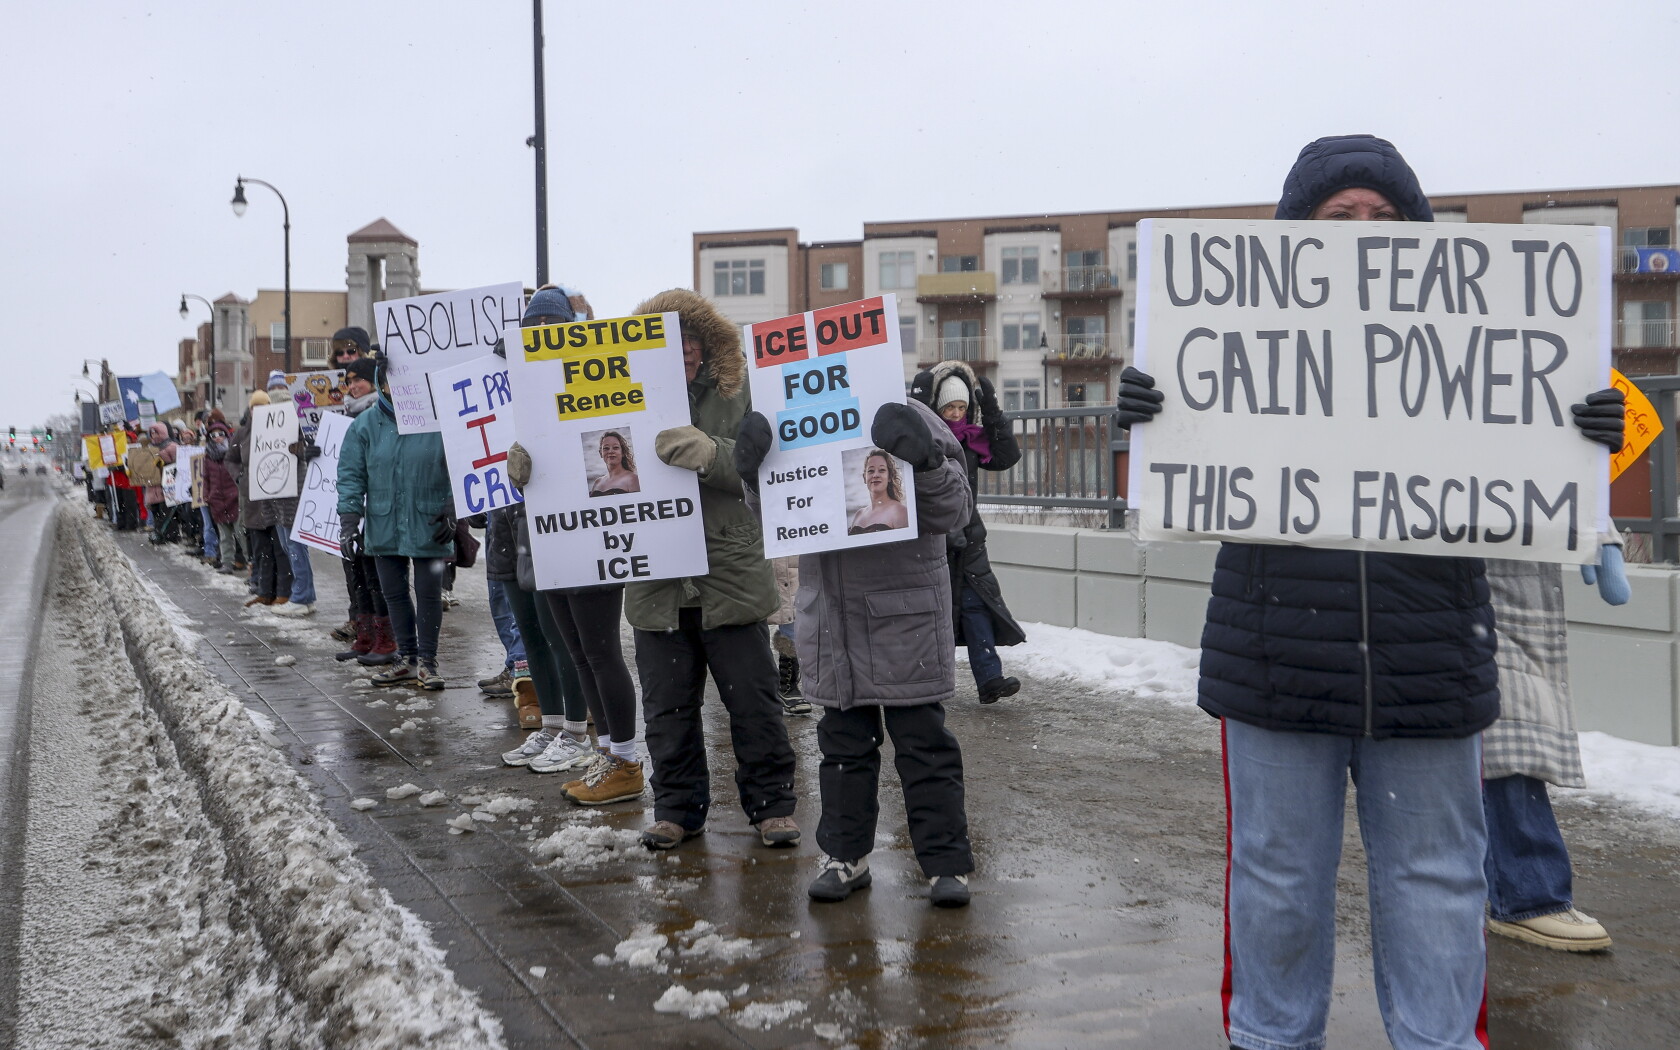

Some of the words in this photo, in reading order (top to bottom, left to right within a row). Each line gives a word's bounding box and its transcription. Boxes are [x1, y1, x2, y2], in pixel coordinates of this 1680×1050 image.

[1165, 232, 1329, 309] USING
[1358, 237, 1490, 315] FEAR
[1512, 240, 1582, 317] TO
[385, 295, 522, 356] ABOLISH
[523, 316, 665, 353] JUSTICE
[754, 325, 807, 359] ICE
[816, 308, 884, 346] OUT
[563, 356, 630, 384] FOR
[784, 364, 850, 400] FOR
[1177, 327, 1333, 417] GAIN
[1365, 323, 1568, 426] POWER
[391, 384, 422, 396] RENEE
[453, 378, 478, 417] I
[557, 388, 644, 415] Renee
[266, 410, 285, 429] NO
[397, 400, 425, 411] NICOLE
[402, 414, 426, 427] GOOD
[779, 407, 861, 443] GOOD
[255, 434, 287, 453] KINGS
[308, 461, 337, 492] Des
[766, 464, 829, 486] Justice
[534, 497, 694, 535] MURDERED
[787, 494, 814, 511] For
[1149, 463, 1257, 531] THIS
[1281, 466, 1320, 534] IS
[1352, 470, 1578, 551] FASCISM
[602, 531, 635, 553] by
[776, 522, 829, 541] Renee
[596, 555, 651, 581] ICE
